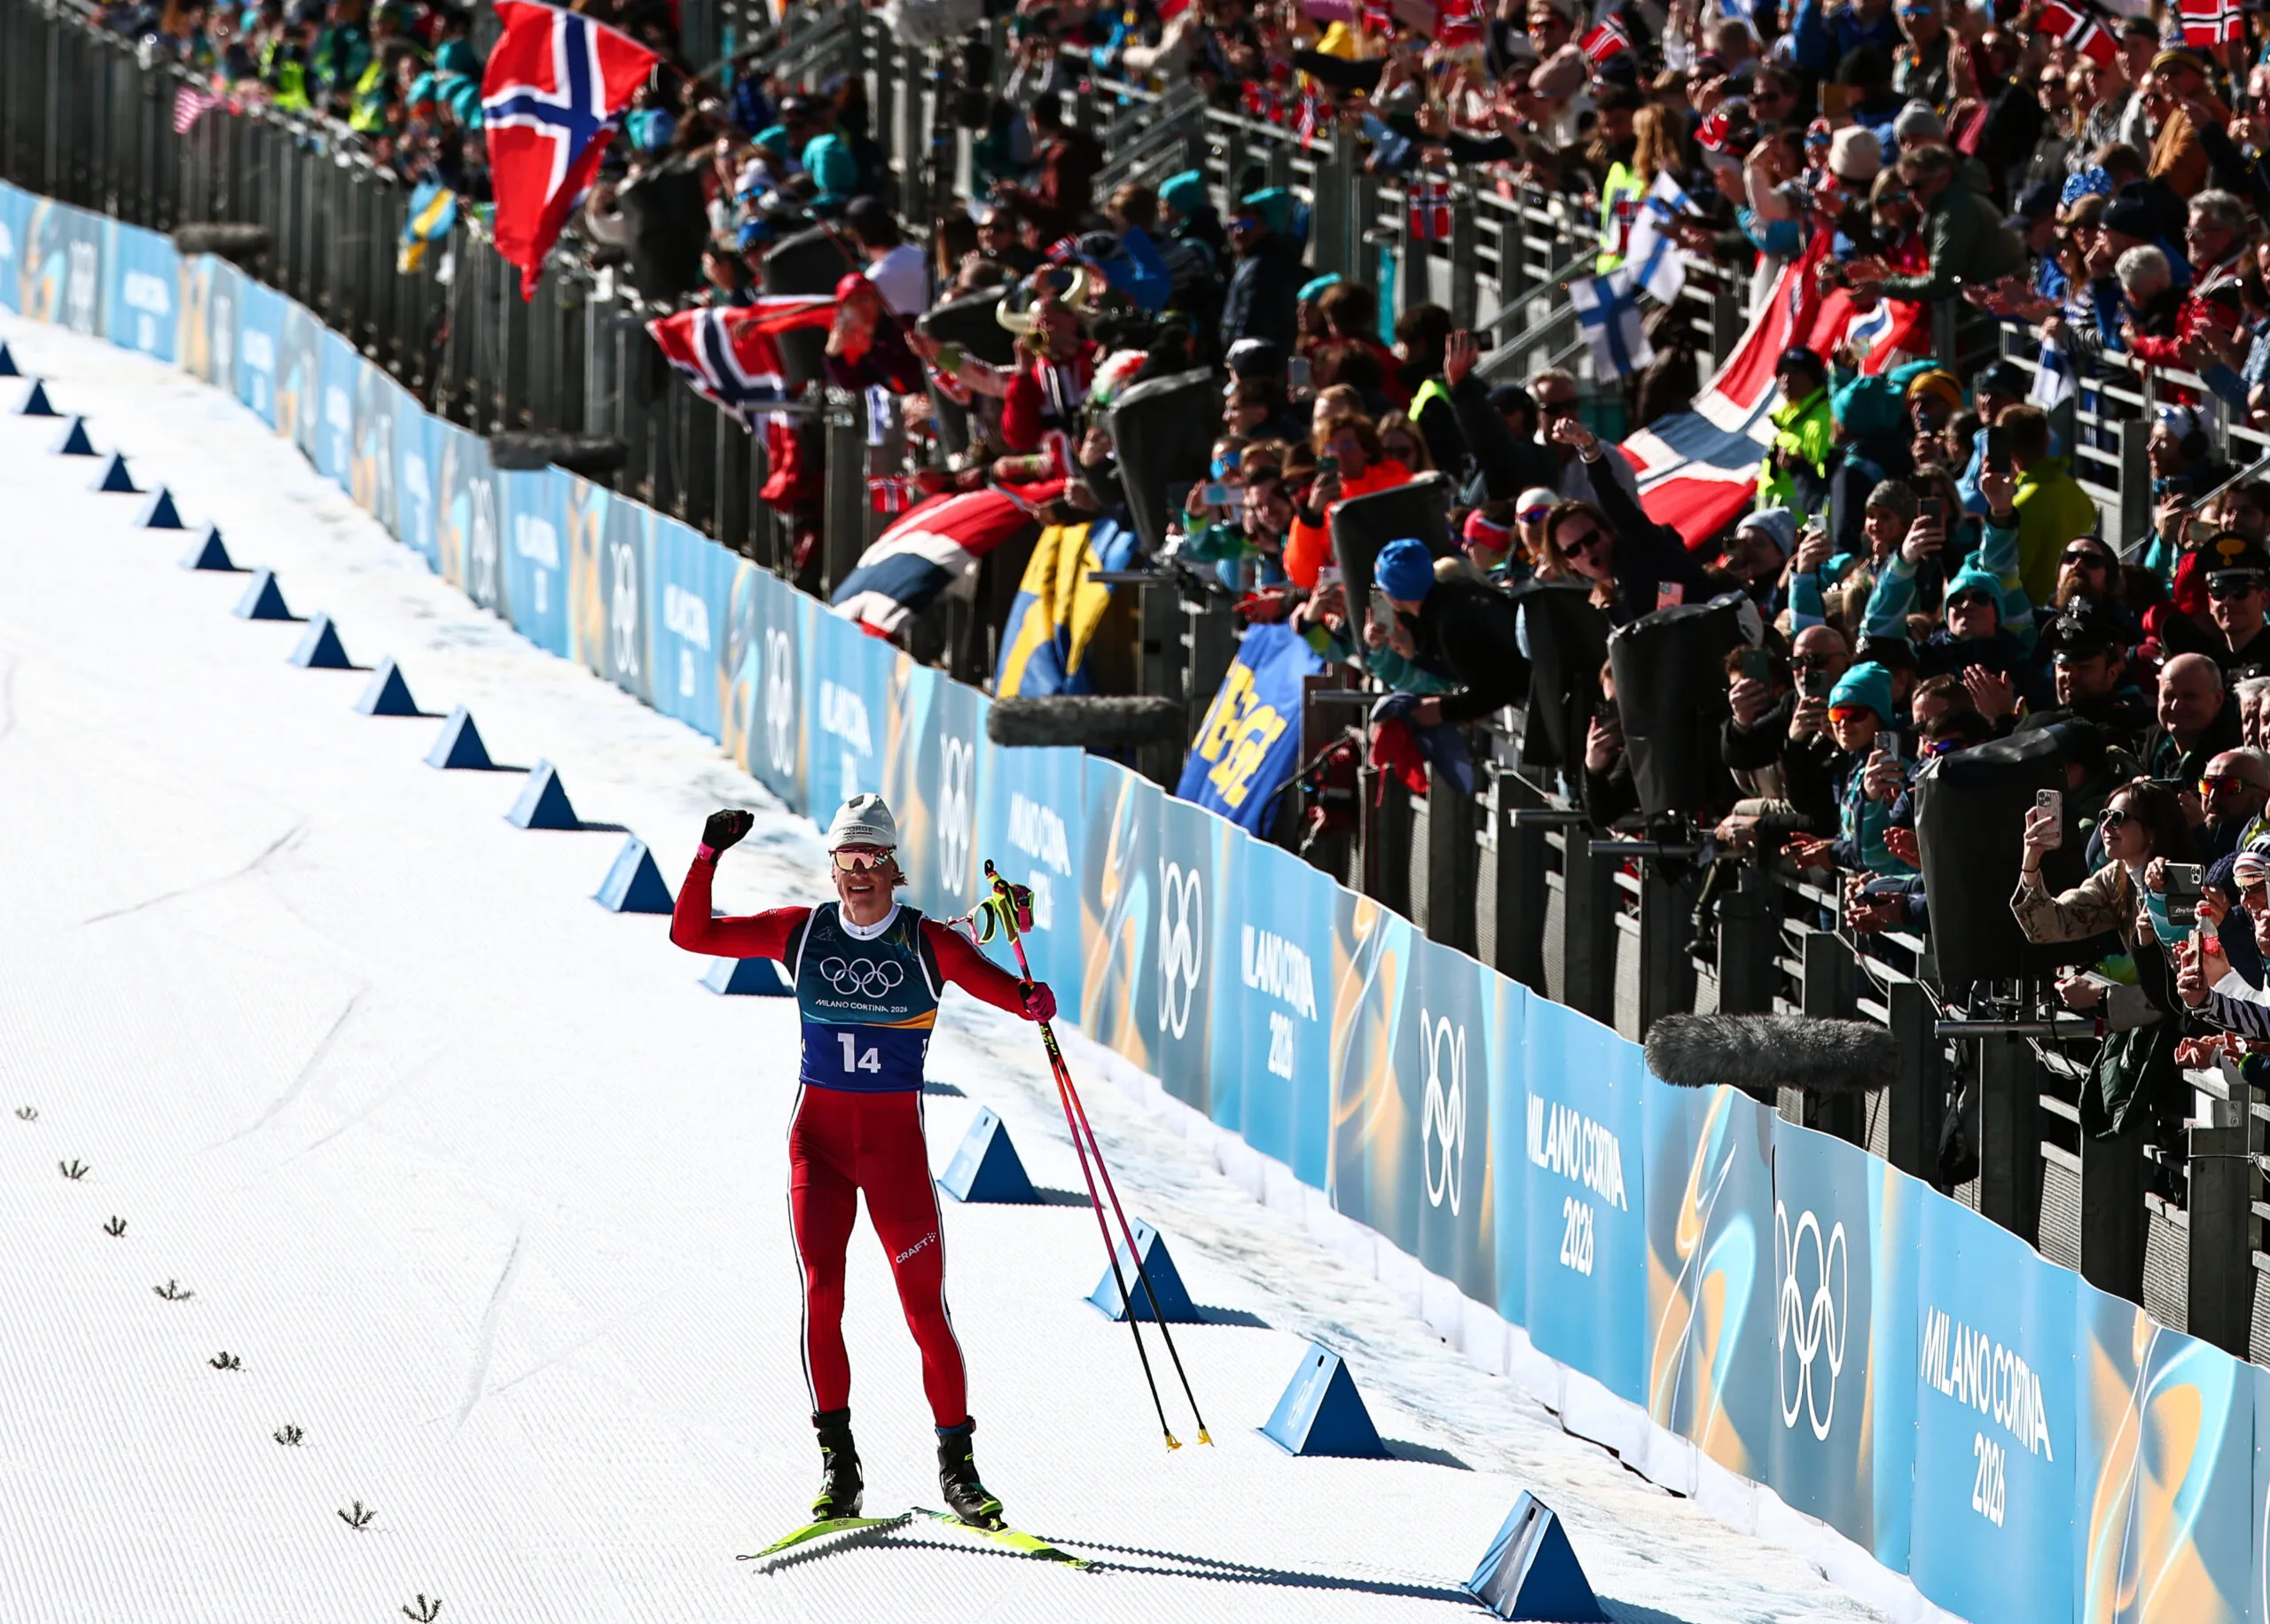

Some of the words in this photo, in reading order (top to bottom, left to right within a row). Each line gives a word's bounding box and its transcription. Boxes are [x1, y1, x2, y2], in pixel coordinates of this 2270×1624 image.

[1242, 923, 1283, 998] ILANO
[815, 998, 849, 1009] MILANO
[849, 1002, 889, 1012] CORTINA
[837, 1032, 881, 1074] 14
[896, 1238, 928, 1263] CRAFT
[1560, 1196, 1594, 1277] 2026
[1920, 1304, 1991, 1415] MILANO
[1992, 1342, 2054, 1462] CORTINA
[1971, 1432, 2006, 1528] 2026
